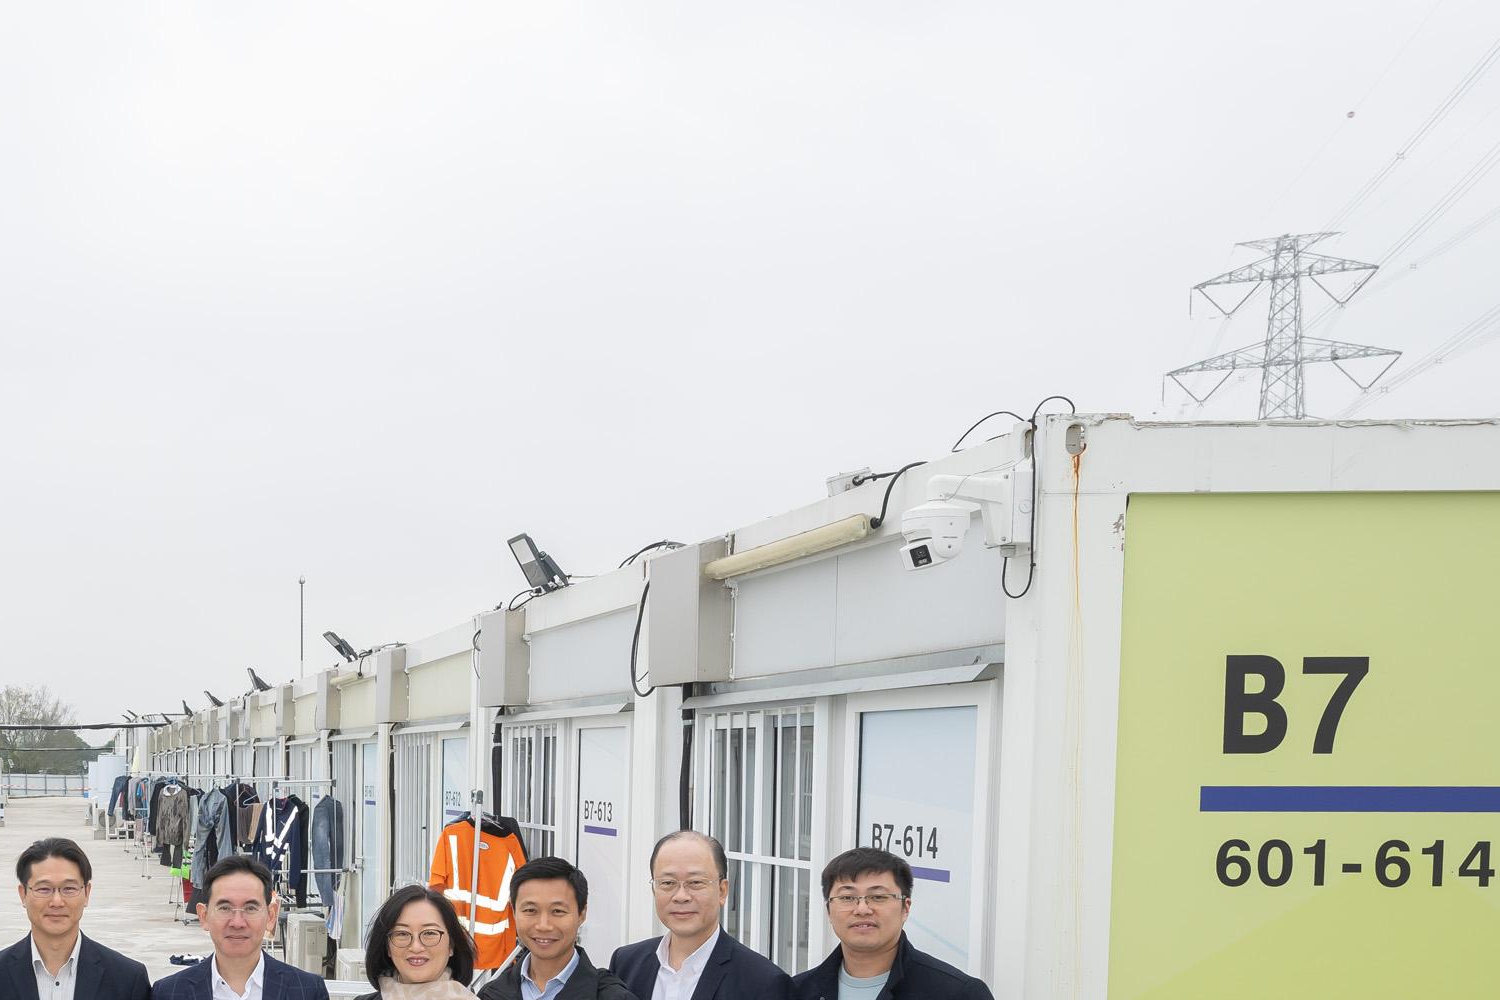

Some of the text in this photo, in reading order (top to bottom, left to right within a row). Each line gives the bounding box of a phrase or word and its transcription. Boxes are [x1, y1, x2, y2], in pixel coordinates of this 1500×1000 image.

[1222, 654, 1370, 755] B7
[445, 791, 461, 807] B7-612
[584, 800, 613, 822] B7-613
[871, 823, 938, 859] B7-614
[1215, 838, 1496, 888] 601-614
